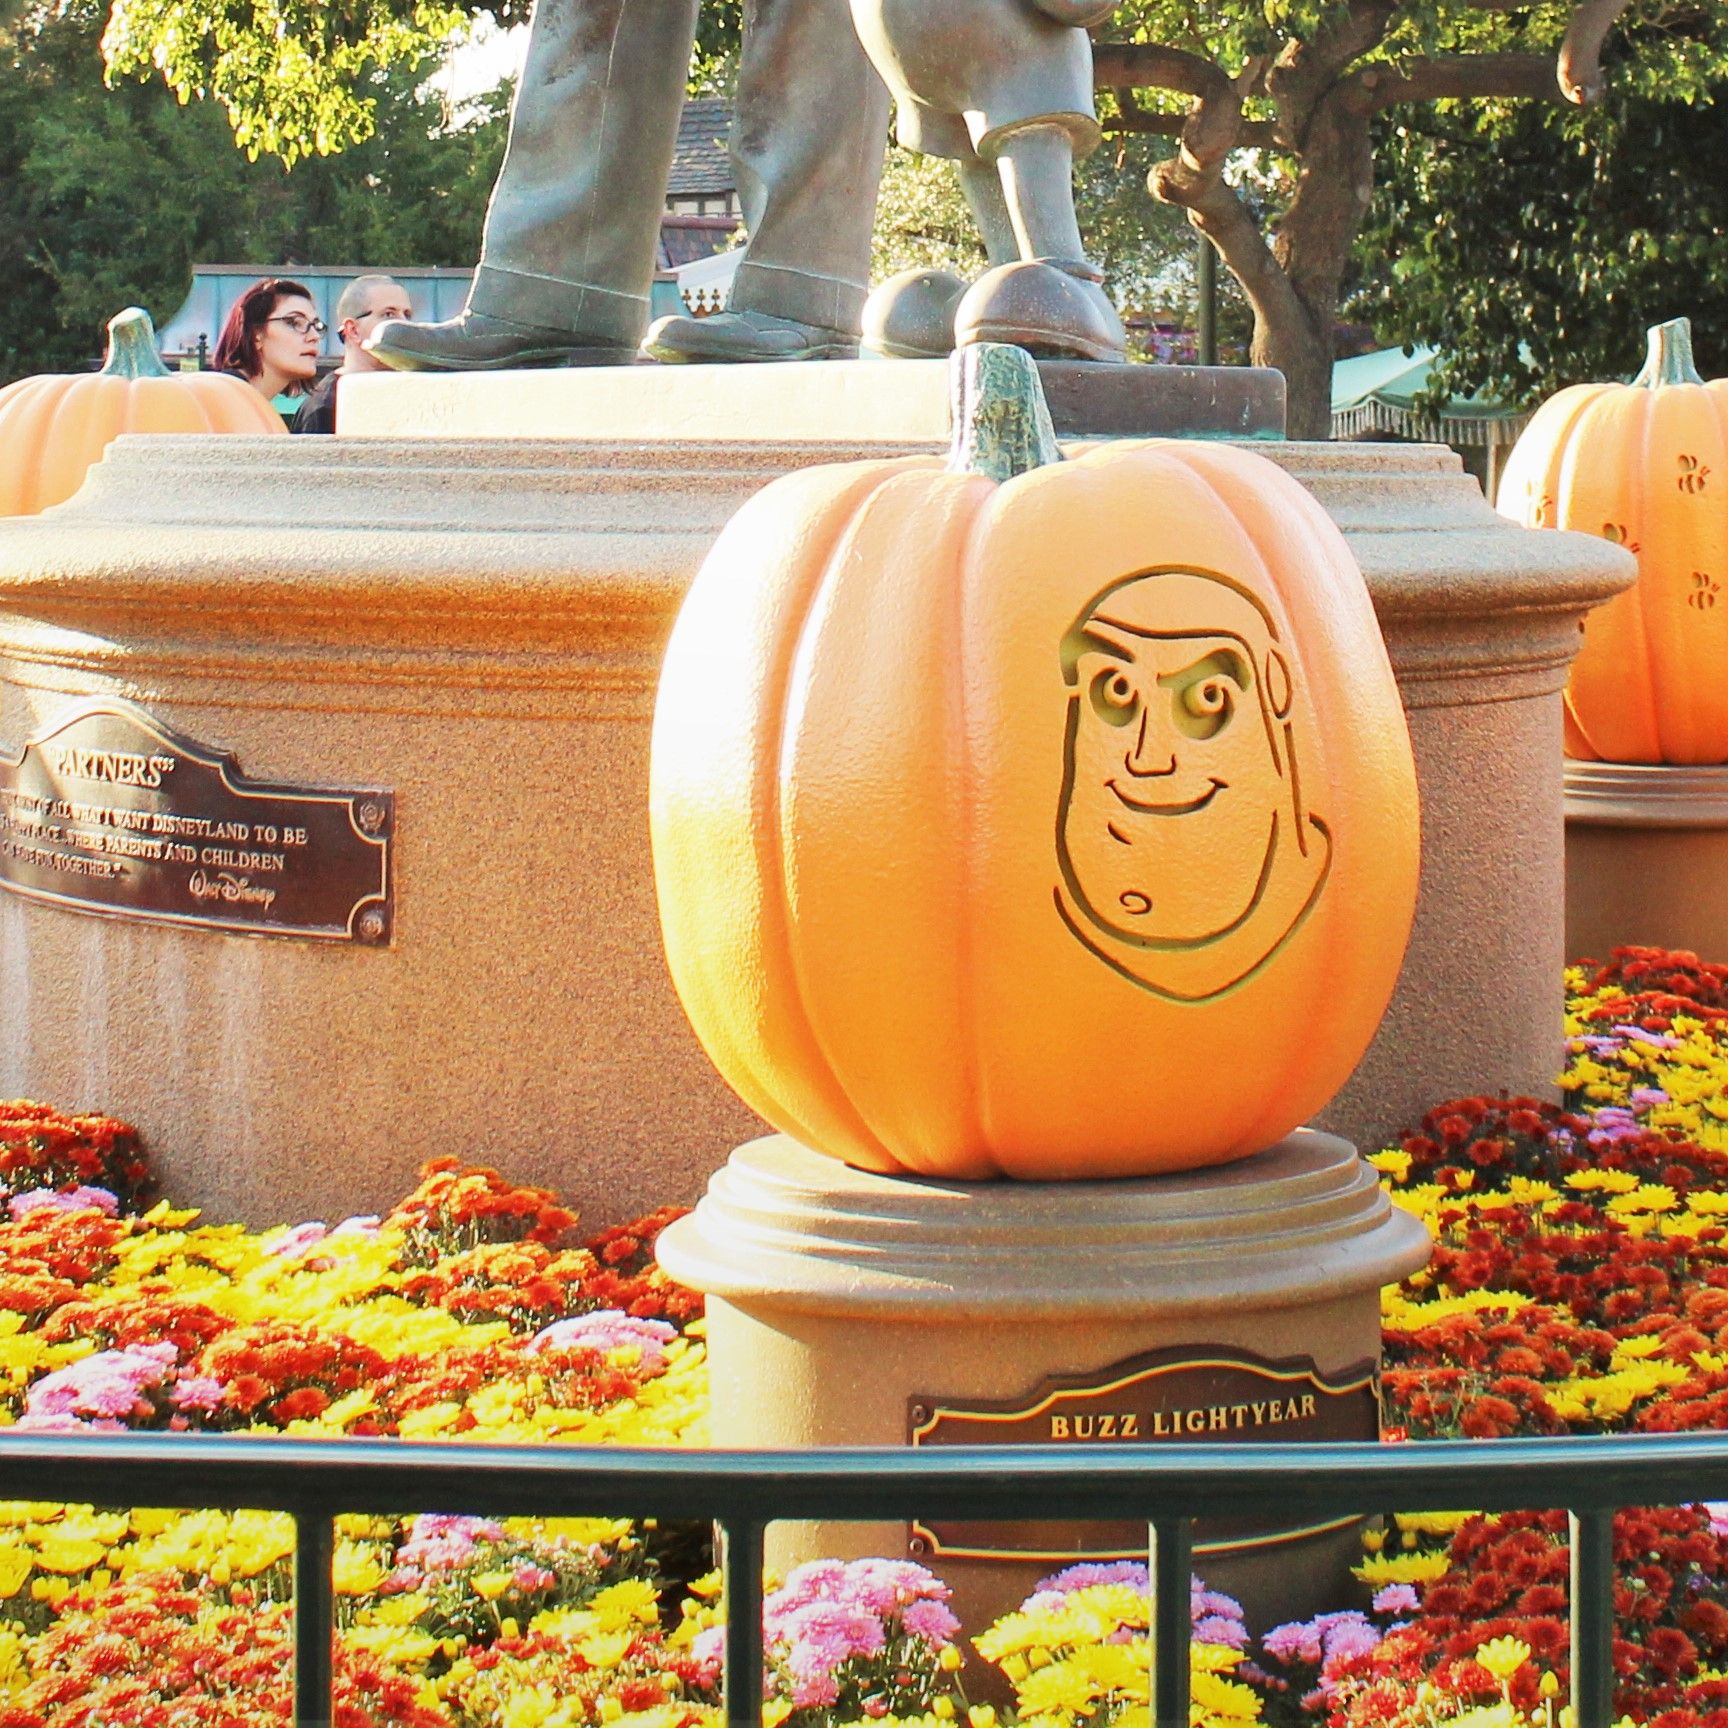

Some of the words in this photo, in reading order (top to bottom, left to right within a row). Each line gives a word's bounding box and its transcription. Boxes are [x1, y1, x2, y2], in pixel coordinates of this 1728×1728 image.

[112, 808, 150, 830] WANT
[152, 812, 249, 842] DISNEYLAND
[254, 825, 278, 843] TO
[283, 827, 308, 846] BE
[105, 834, 162, 860] PARENTS
[165, 841, 197, 863] AND
[201, 847, 286, 871] CHILDREN
[1051, 1414, 1138, 1440] BUZZ
[1153, 1394, 1317, 1434] LIGHTYEAR
